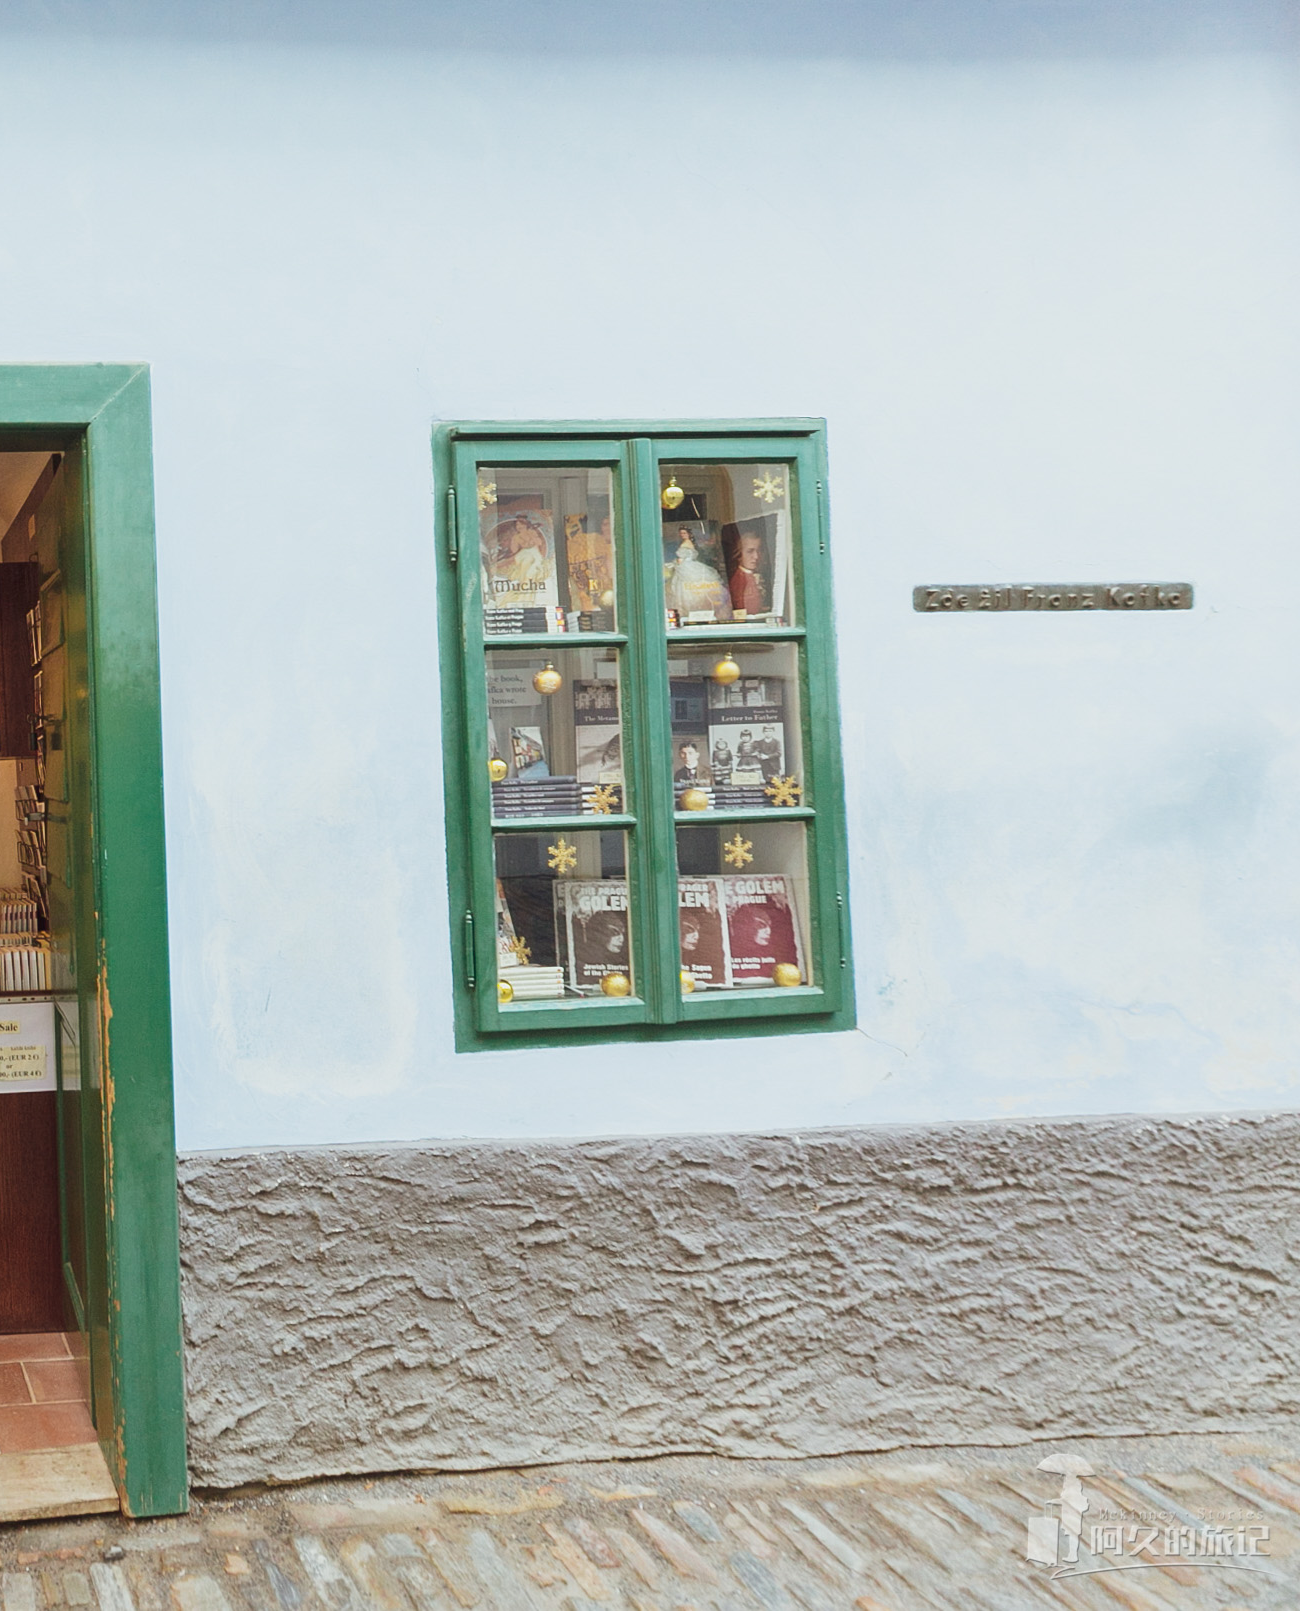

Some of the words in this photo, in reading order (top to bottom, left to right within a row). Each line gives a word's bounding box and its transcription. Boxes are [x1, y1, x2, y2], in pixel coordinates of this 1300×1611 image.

[494, 578, 547, 593] Mucha
[925, 588, 969, 609] Zde
[1022, 586, 1095, 608] Franz
[1105, 584, 1183, 608] Kafka
[500, 674, 523, 683] book,
[754, 713, 779, 721] Father
[735, 880, 785, 895] GOLEM
[732, 895, 768, 904] PRAGUE
